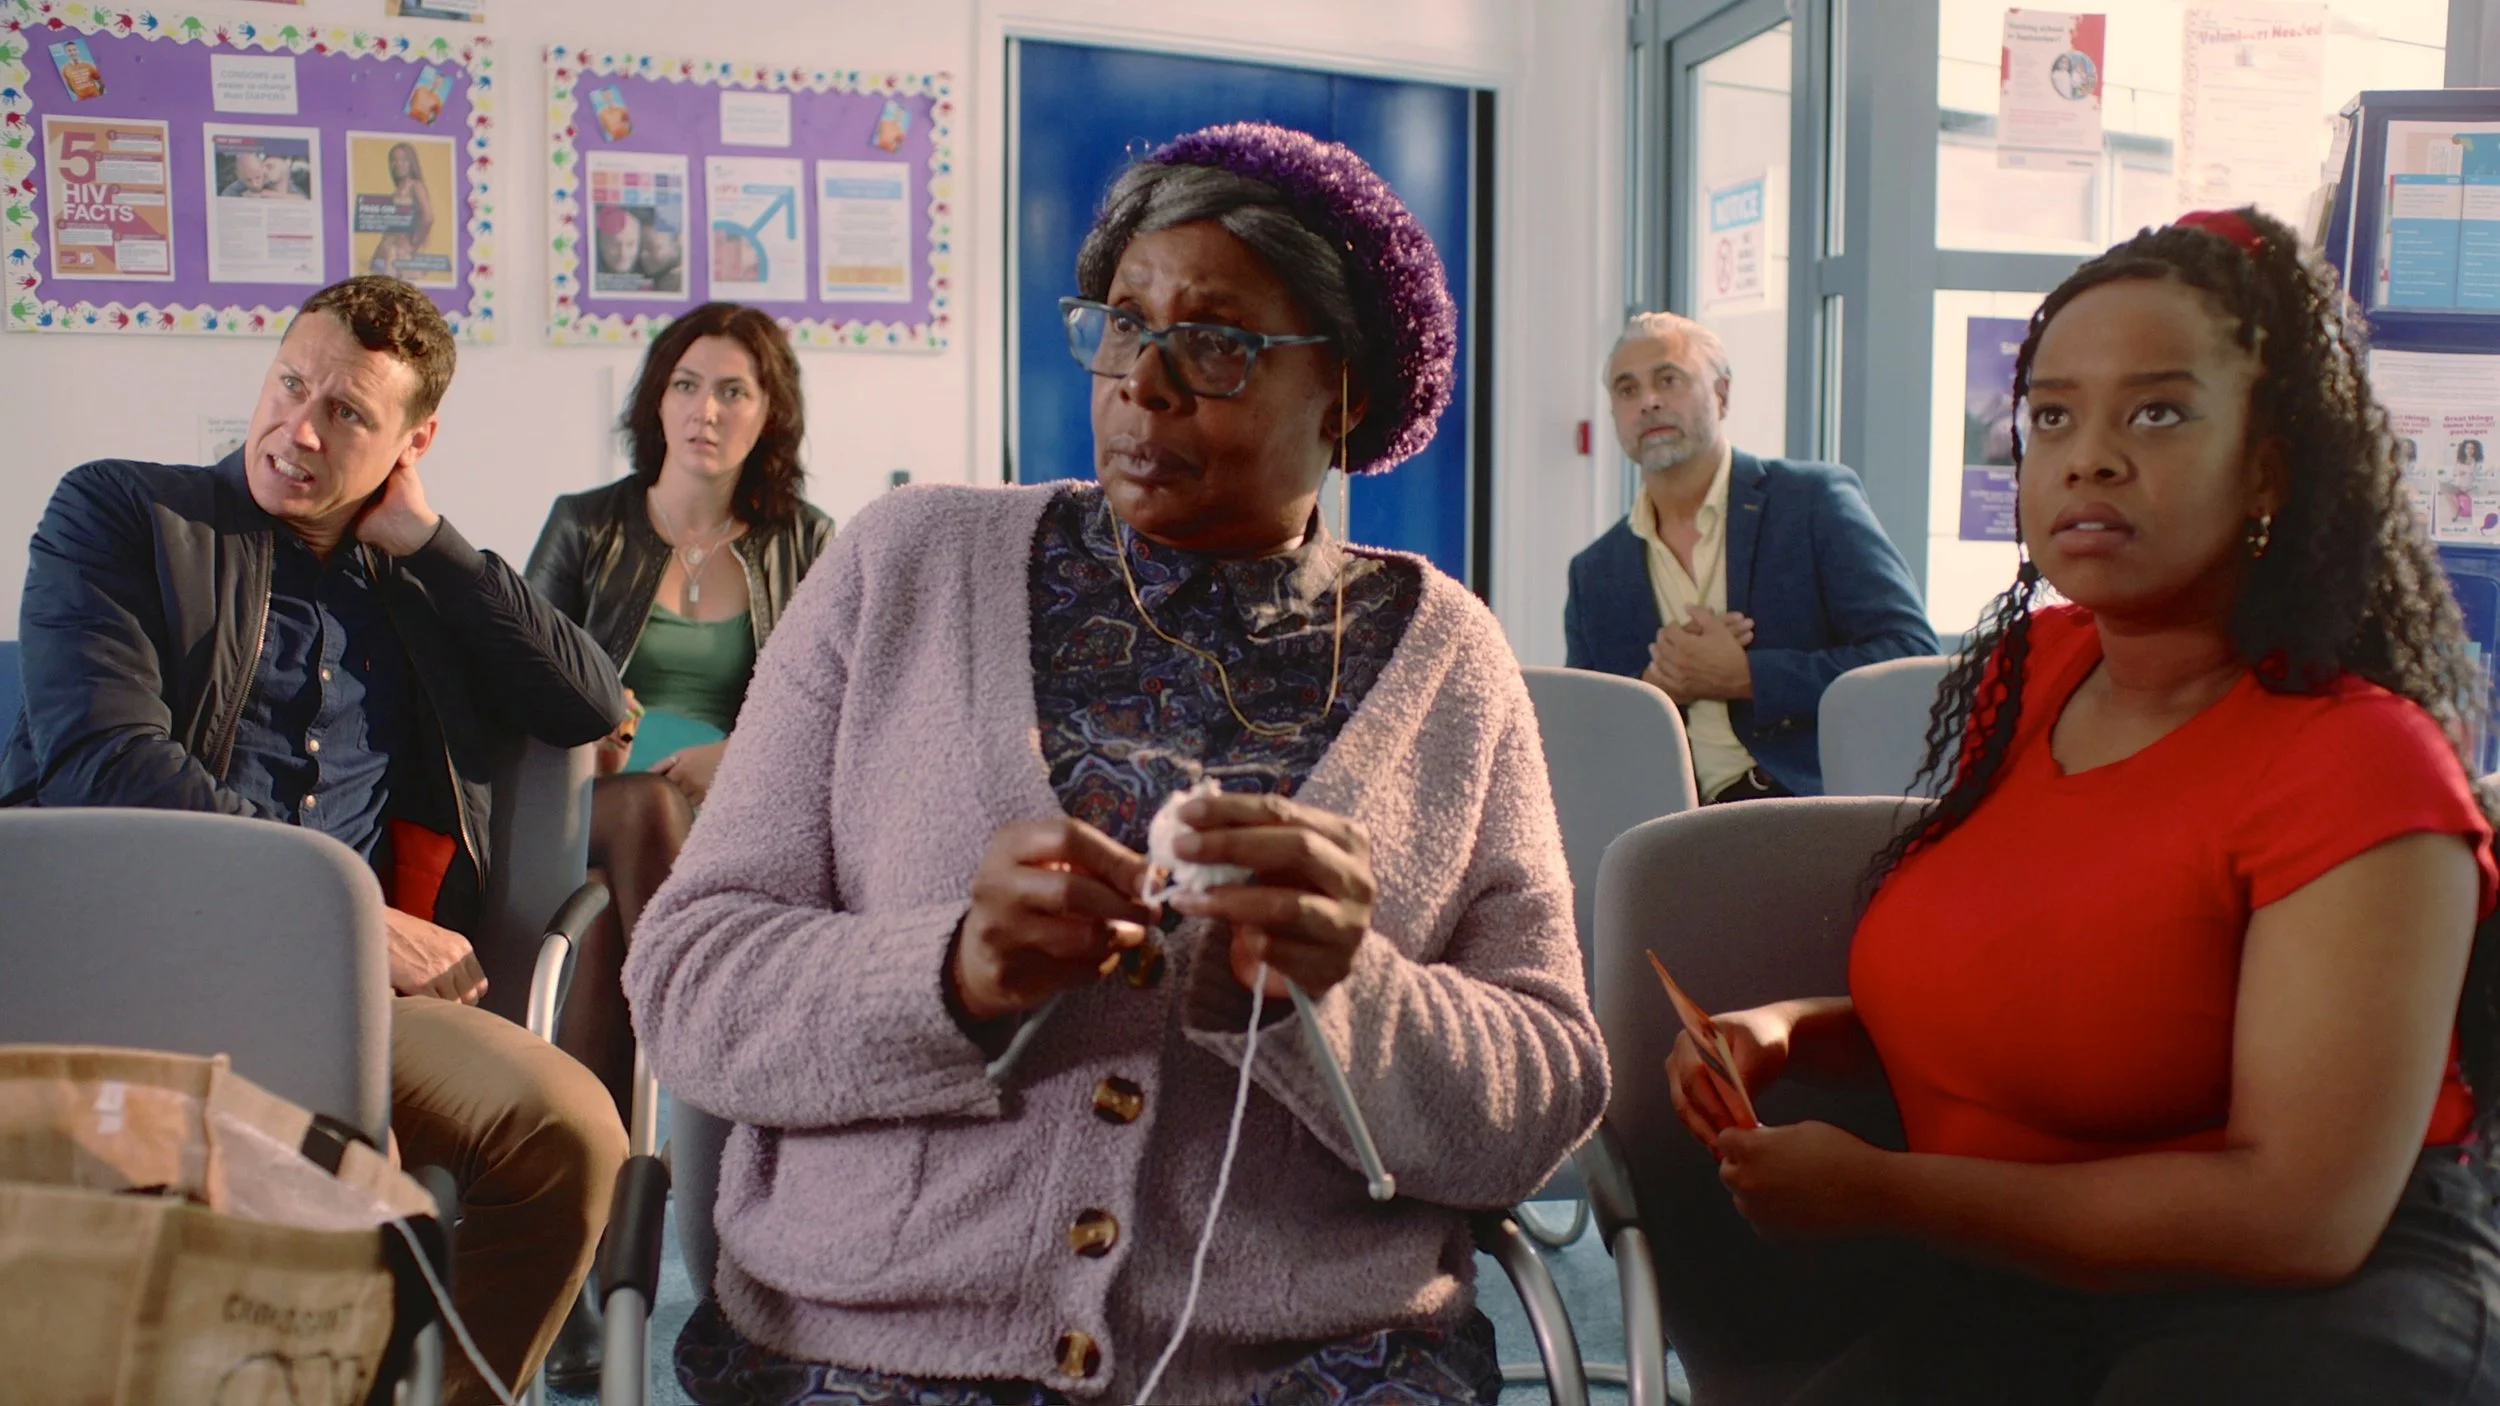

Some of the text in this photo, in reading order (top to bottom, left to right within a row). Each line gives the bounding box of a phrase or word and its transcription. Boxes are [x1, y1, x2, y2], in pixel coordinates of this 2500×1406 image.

[59, 131, 96, 184] 5
[63, 183, 108, 203] HIV
[64, 203, 135, 222] FACTS
[1716, 189, 1758, 225] NOTICE
[2468, 414, 2494, 423] things
[2450, 427, 2488, 436] packages
